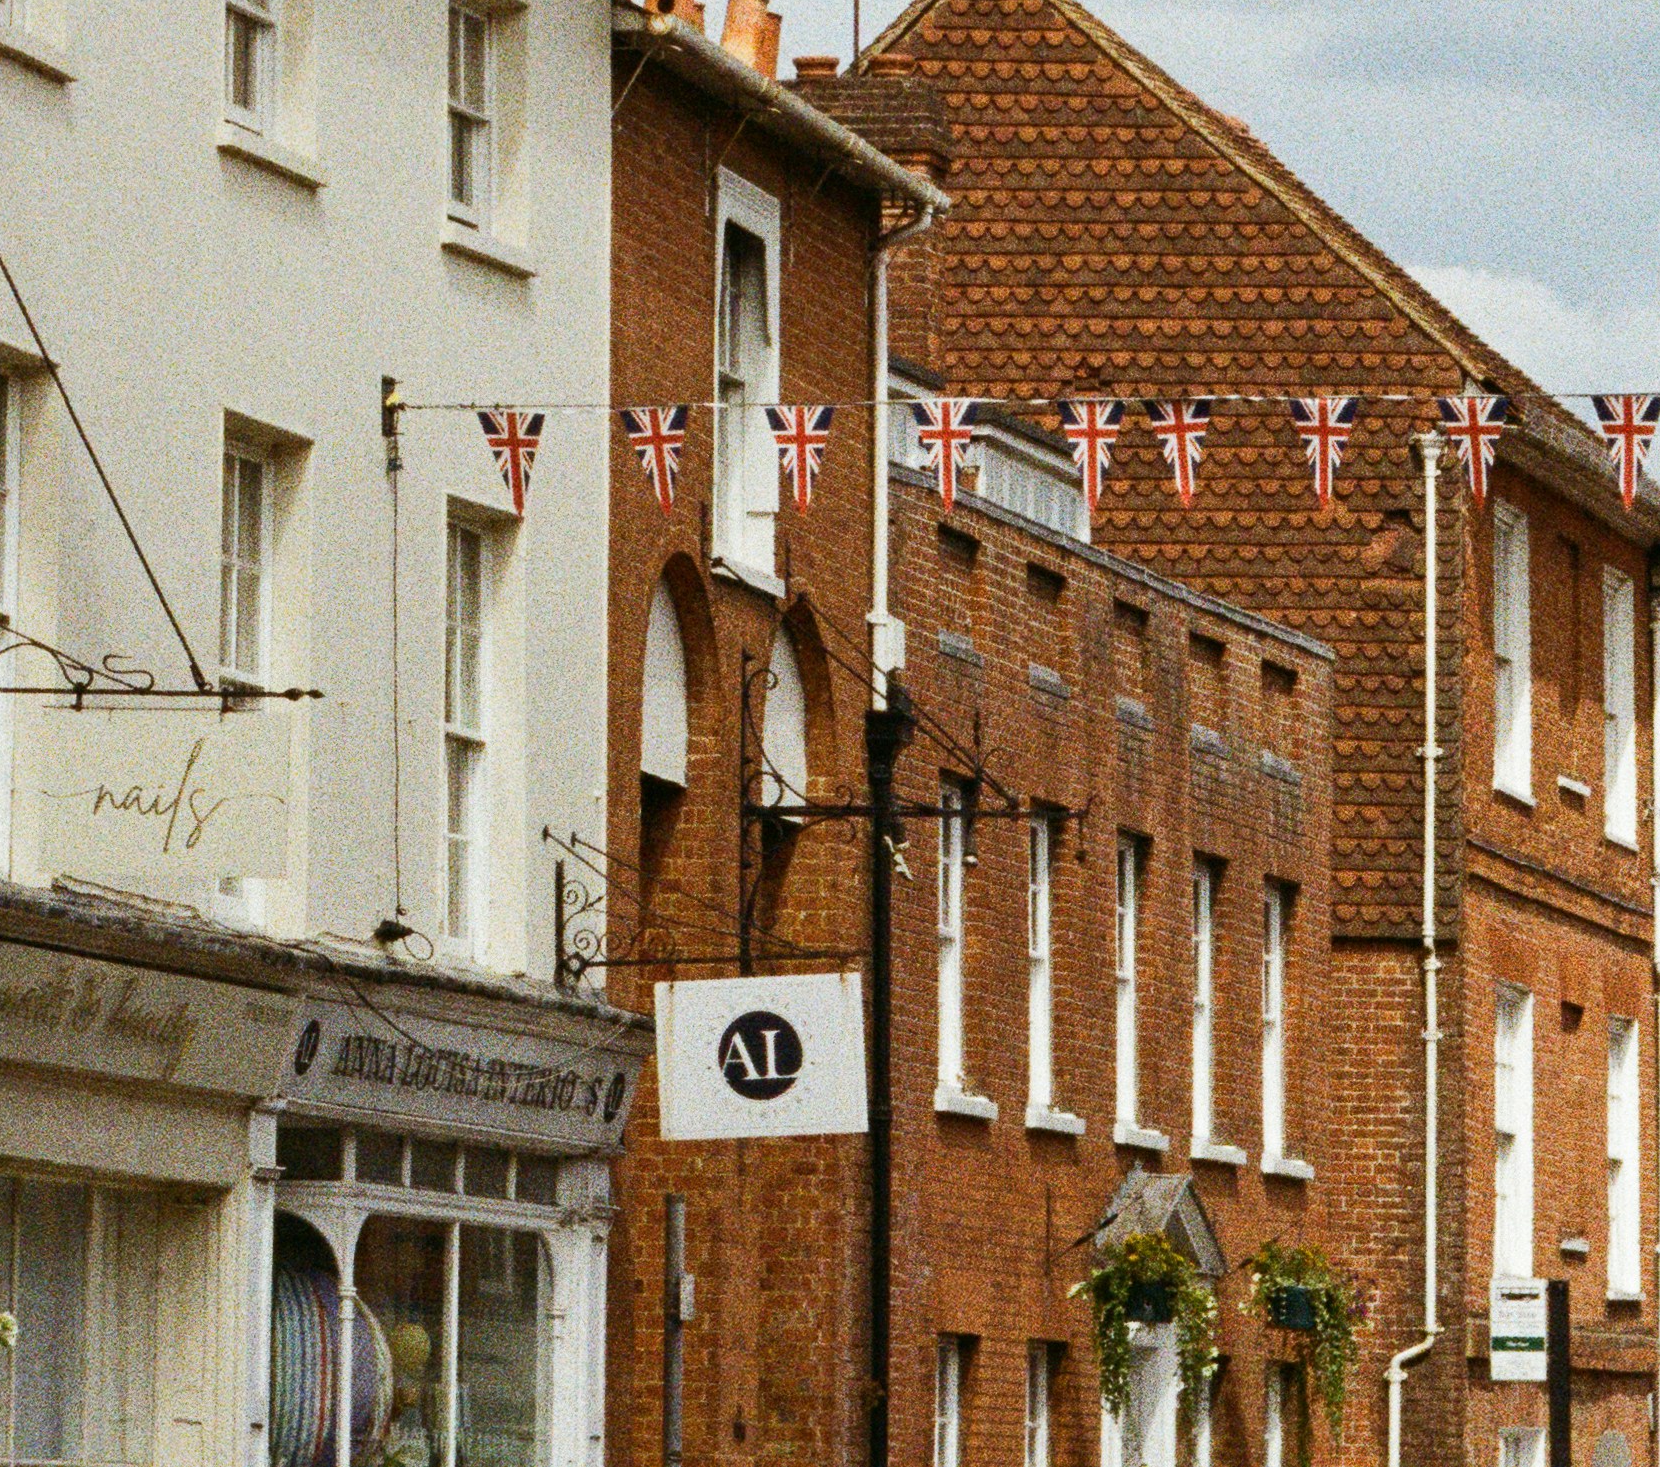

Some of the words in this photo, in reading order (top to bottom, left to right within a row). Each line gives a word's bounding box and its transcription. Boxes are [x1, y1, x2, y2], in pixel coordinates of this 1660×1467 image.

[90, 736, 227, 854] nails
[331, 1034, 397, 1085] ANNA
[721, 1030, 799, 1081] AL
